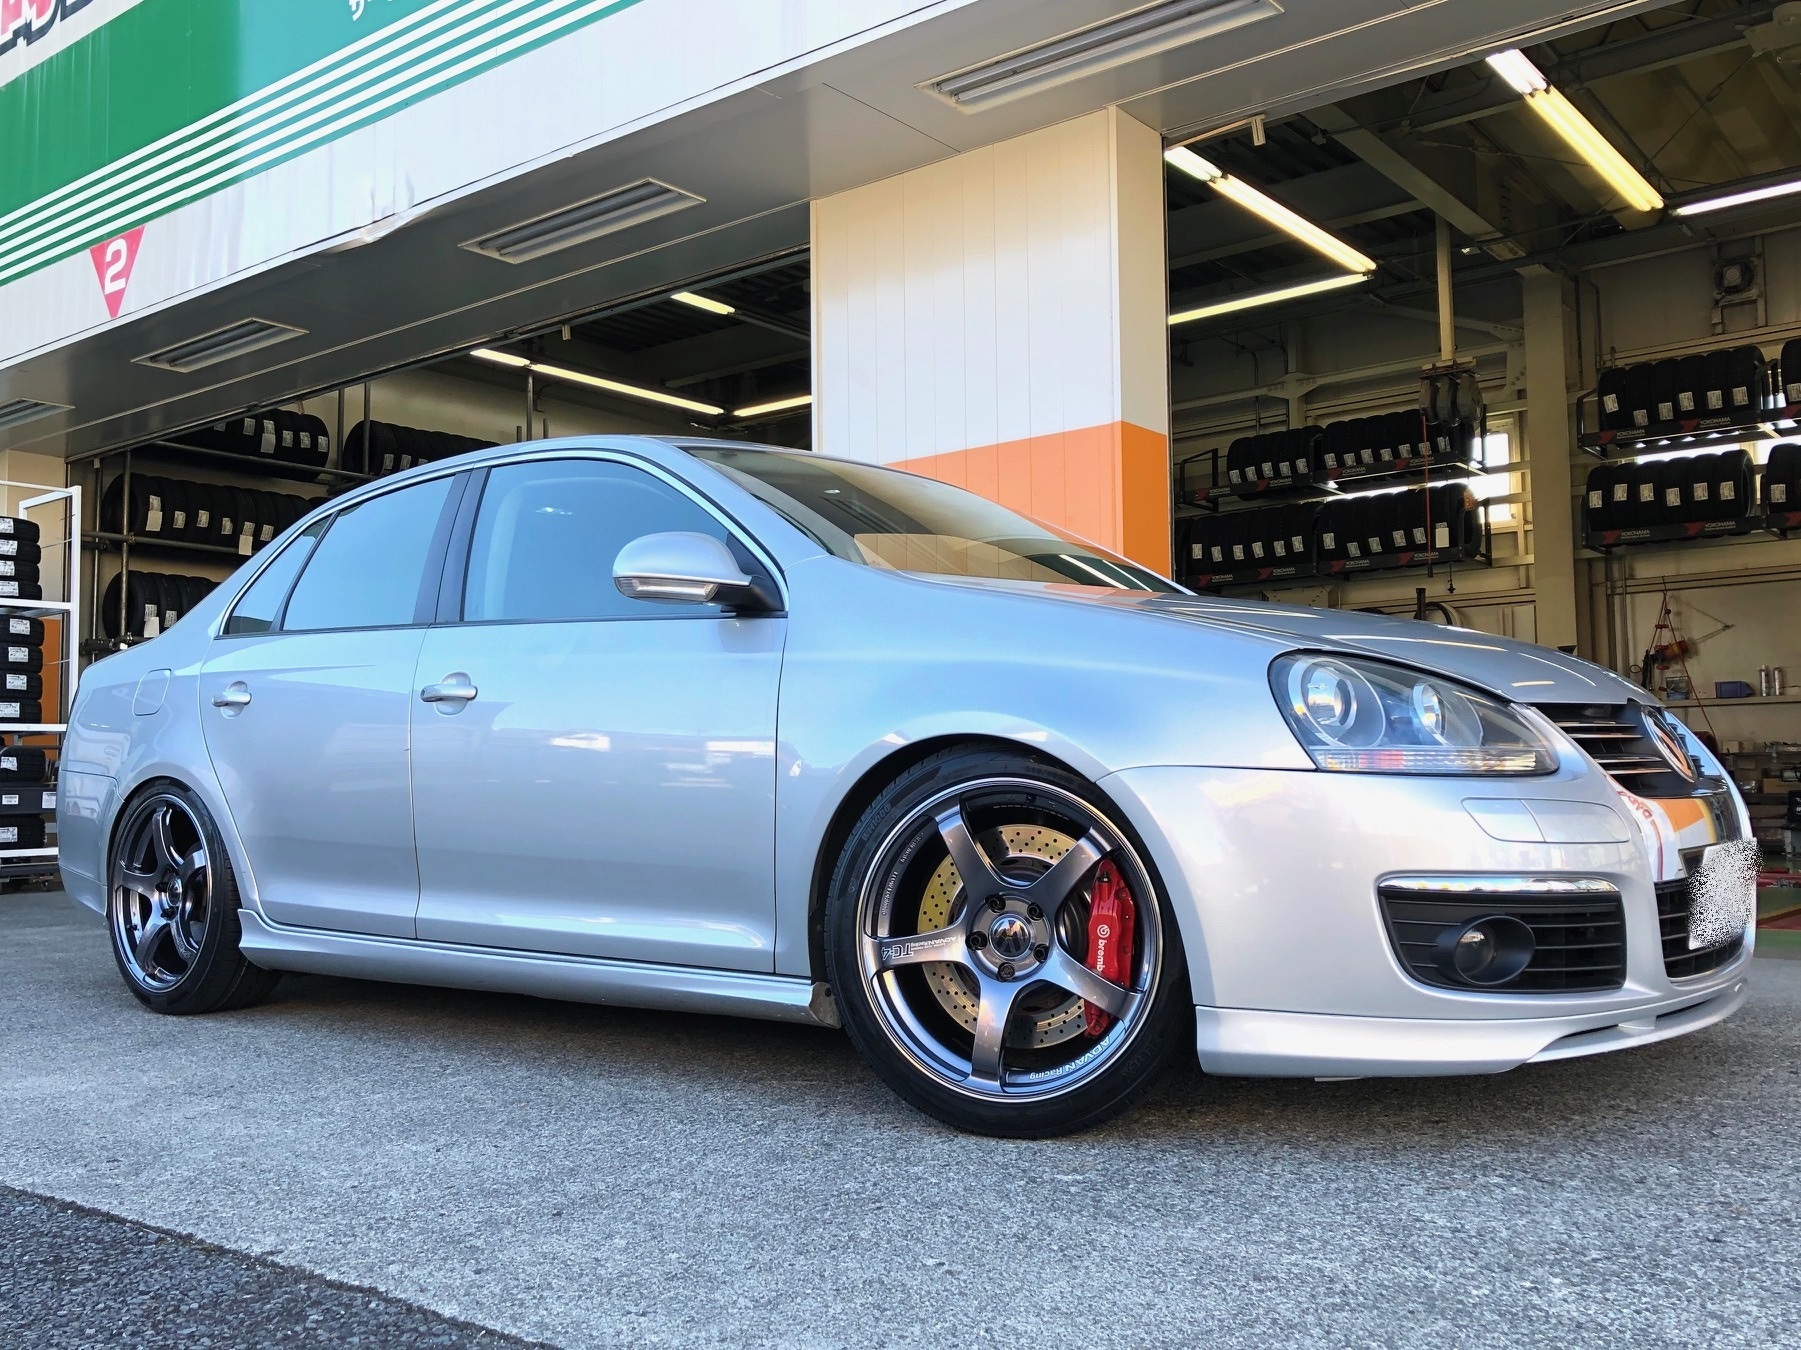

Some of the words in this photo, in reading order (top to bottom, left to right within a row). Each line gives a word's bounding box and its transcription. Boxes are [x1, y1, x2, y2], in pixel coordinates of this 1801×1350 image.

[104, 238, 127, 295] 2
[1700, 416, 1731, 425] YOKOHAMA
[1616, 428, 1645, 437] YOKOHAMA
[1704, 520, 1736, 529] YOKOHAMA
[1621, 529, 1650, 538] YOKOHAMA
[1096, 938, 1107, 973] bremb
[1065, 1035, 1111, 1072] ADVAN
[1029, 1068, 1063, 1080] Racing
